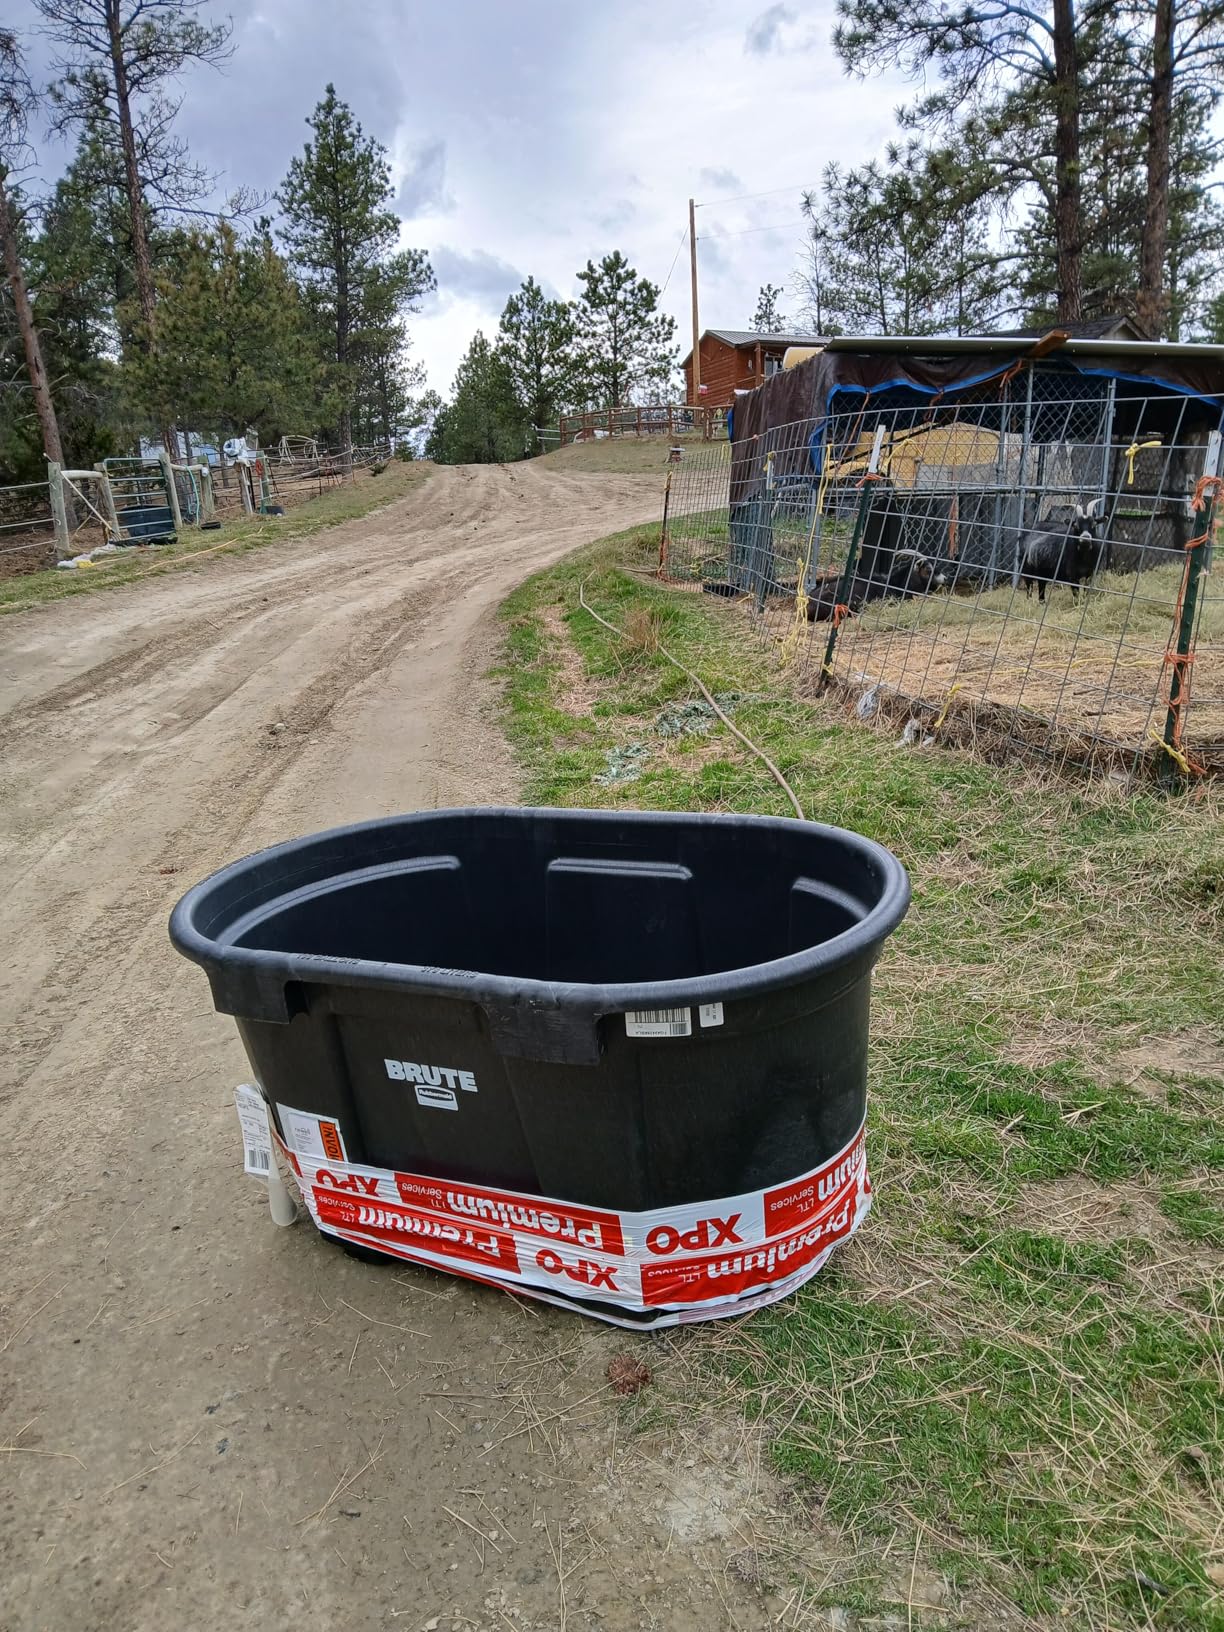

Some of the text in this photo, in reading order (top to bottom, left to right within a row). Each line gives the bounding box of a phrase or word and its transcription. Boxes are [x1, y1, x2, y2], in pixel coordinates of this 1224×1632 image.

[384, 1059, 478, 1092] BRUTE
[401, 1182, 442, 1199] Services
[771, 1186, 815, 1211] Services
[340, 1211, 355, 1223] LTL
[797, 1197, 815, 1213] LTL
[447, 1191, 604, 1249] Premium
[646, 1213, 744, 1255] XPO
[535, 1249, 620, 1291] XPO
[678, 1272, 701, 1283] LTL
